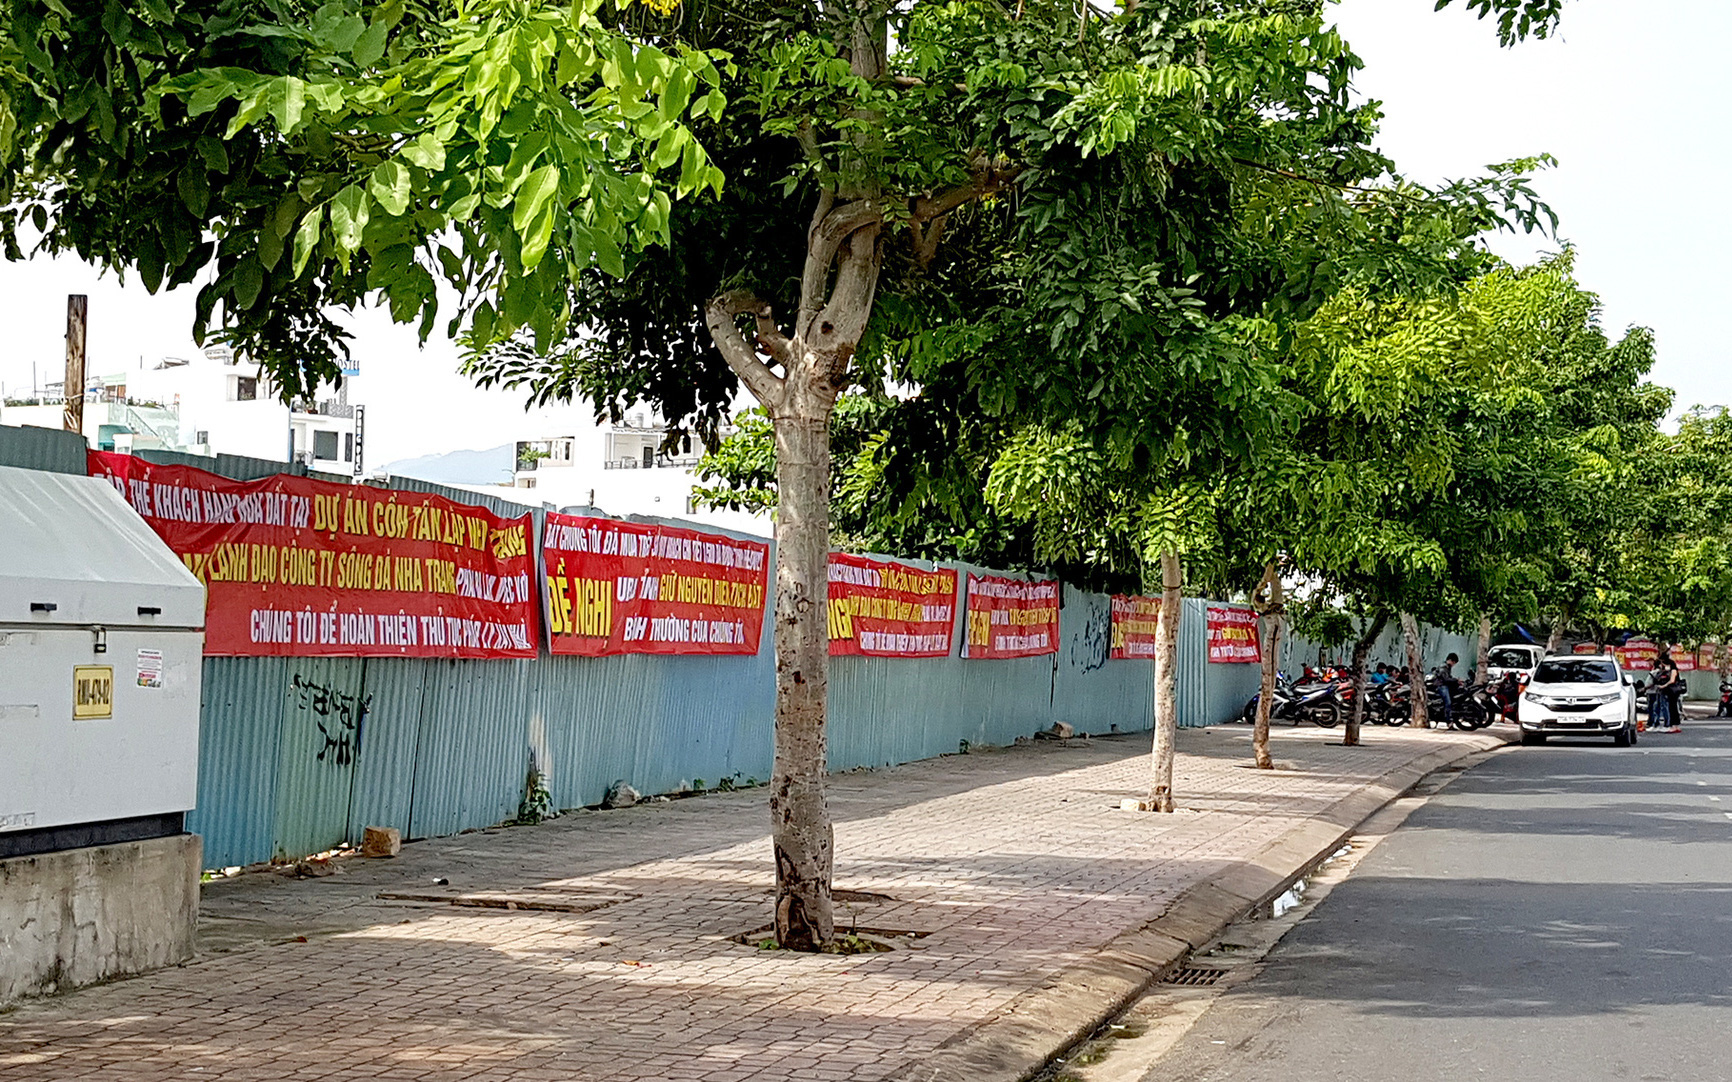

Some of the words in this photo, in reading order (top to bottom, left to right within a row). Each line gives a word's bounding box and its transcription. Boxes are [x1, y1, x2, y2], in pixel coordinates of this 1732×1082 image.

[129, 467, 153, 518] THỂ
[153, 479, 201, 523] KHÁCH
[202, 484, 235, 524] HÀNG
[291, 494, 310, 536] TẠI
[314, 493, 341, 541] DỰ
[344, 490, 369, 537] ÁN
[373, 491, 409, 540] CỒN
[412, 499, 442, 542] TÂN
[442, 505, 466, 553] LẬP
[587, 524, 603, 554] TÔI
[252, 543, 278, 592] ĐẠO
[281, 539, 317, 587] CÔNG
[320, 550, 336, 588] TY
[338, 546, 373, 590] SÔNG
[395, 556, 424, 593] NHA
[425, 558, 457, 595] TRANG
[677, 572, 714, 606] NGUYÊN
[251, 602, 293, 644] CHÚNG
[296, 605, 316, 644] TÔI
[320, 600, 338, 645] ĐỂ
[340, 608, 375, 645] HOÀN
[377, 609, 417, 653] THIỆN
[420, 606, 446, 646] THỦ
[547, 557, 573, 634] ĐỀ
[574, 577, 612, 649] NGHỊ
[623, 612, 648, 641] BÌH
[649, 612, 690, 642] THƯỜNG
[691, 612, 709, 643] CỦA
